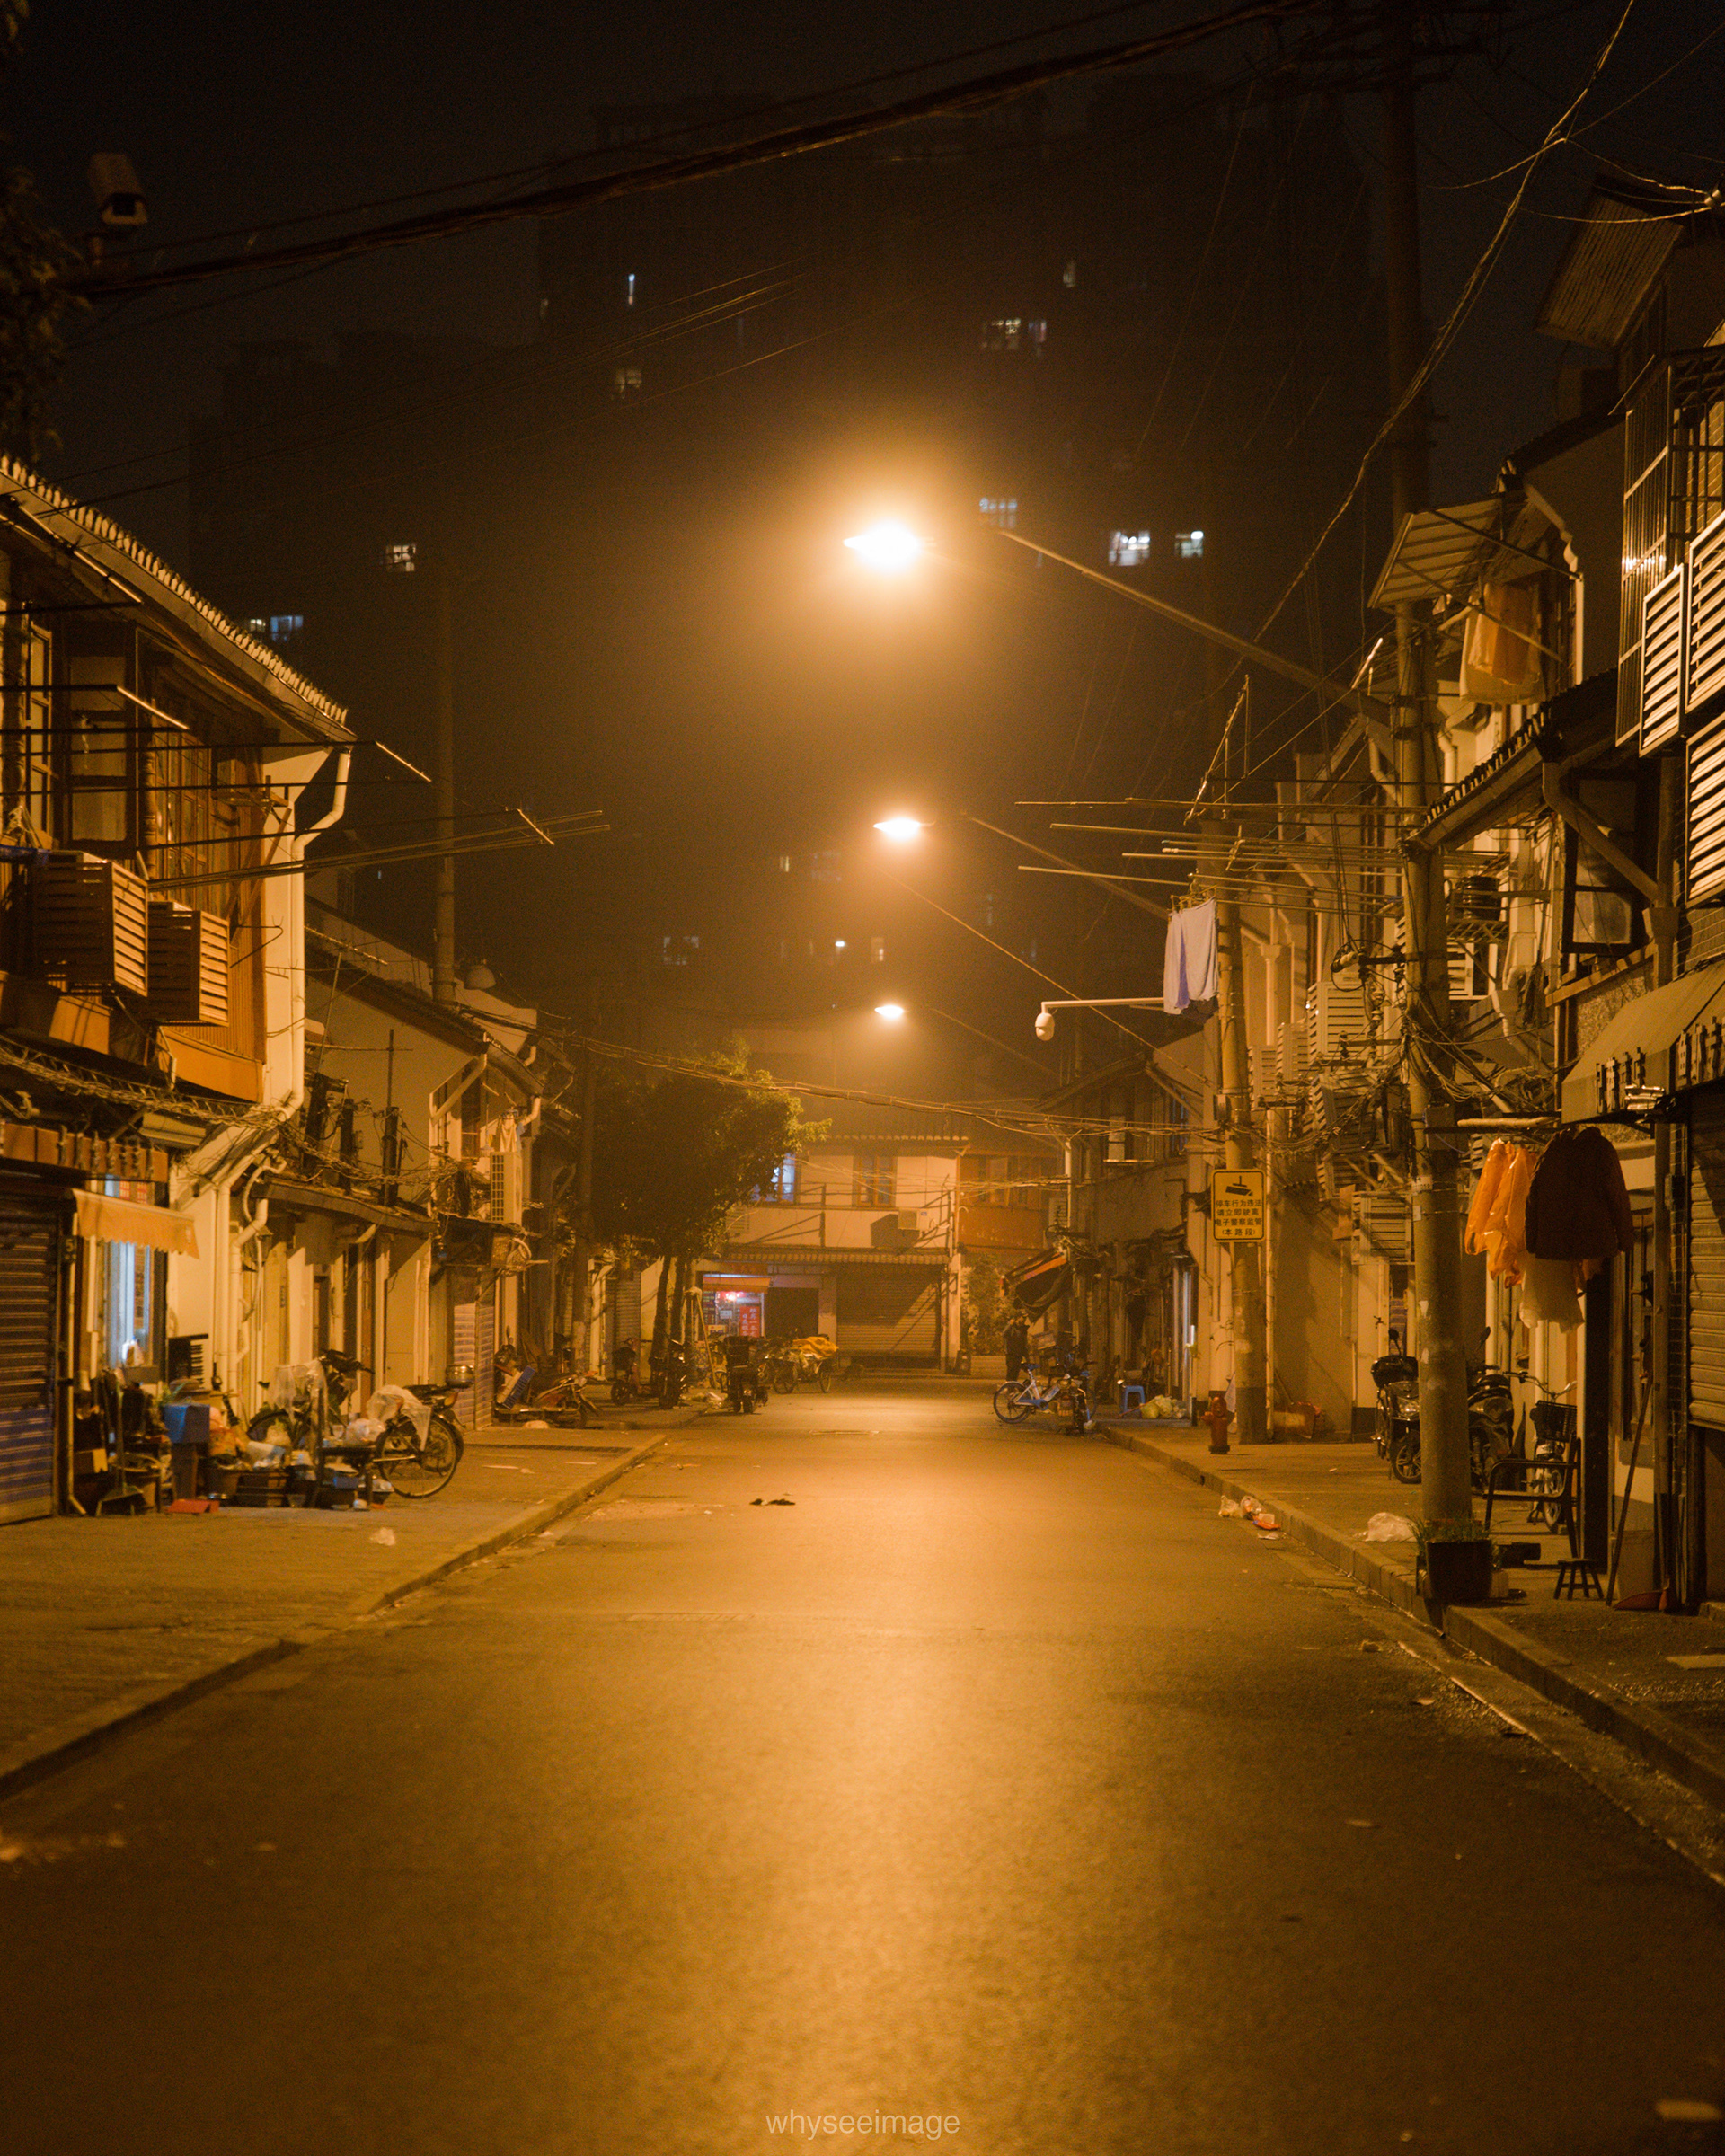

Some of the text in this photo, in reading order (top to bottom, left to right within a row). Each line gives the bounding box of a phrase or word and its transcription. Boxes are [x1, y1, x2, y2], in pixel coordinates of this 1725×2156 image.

[1216, 1199, 1262, 1207] 停车行为违法
